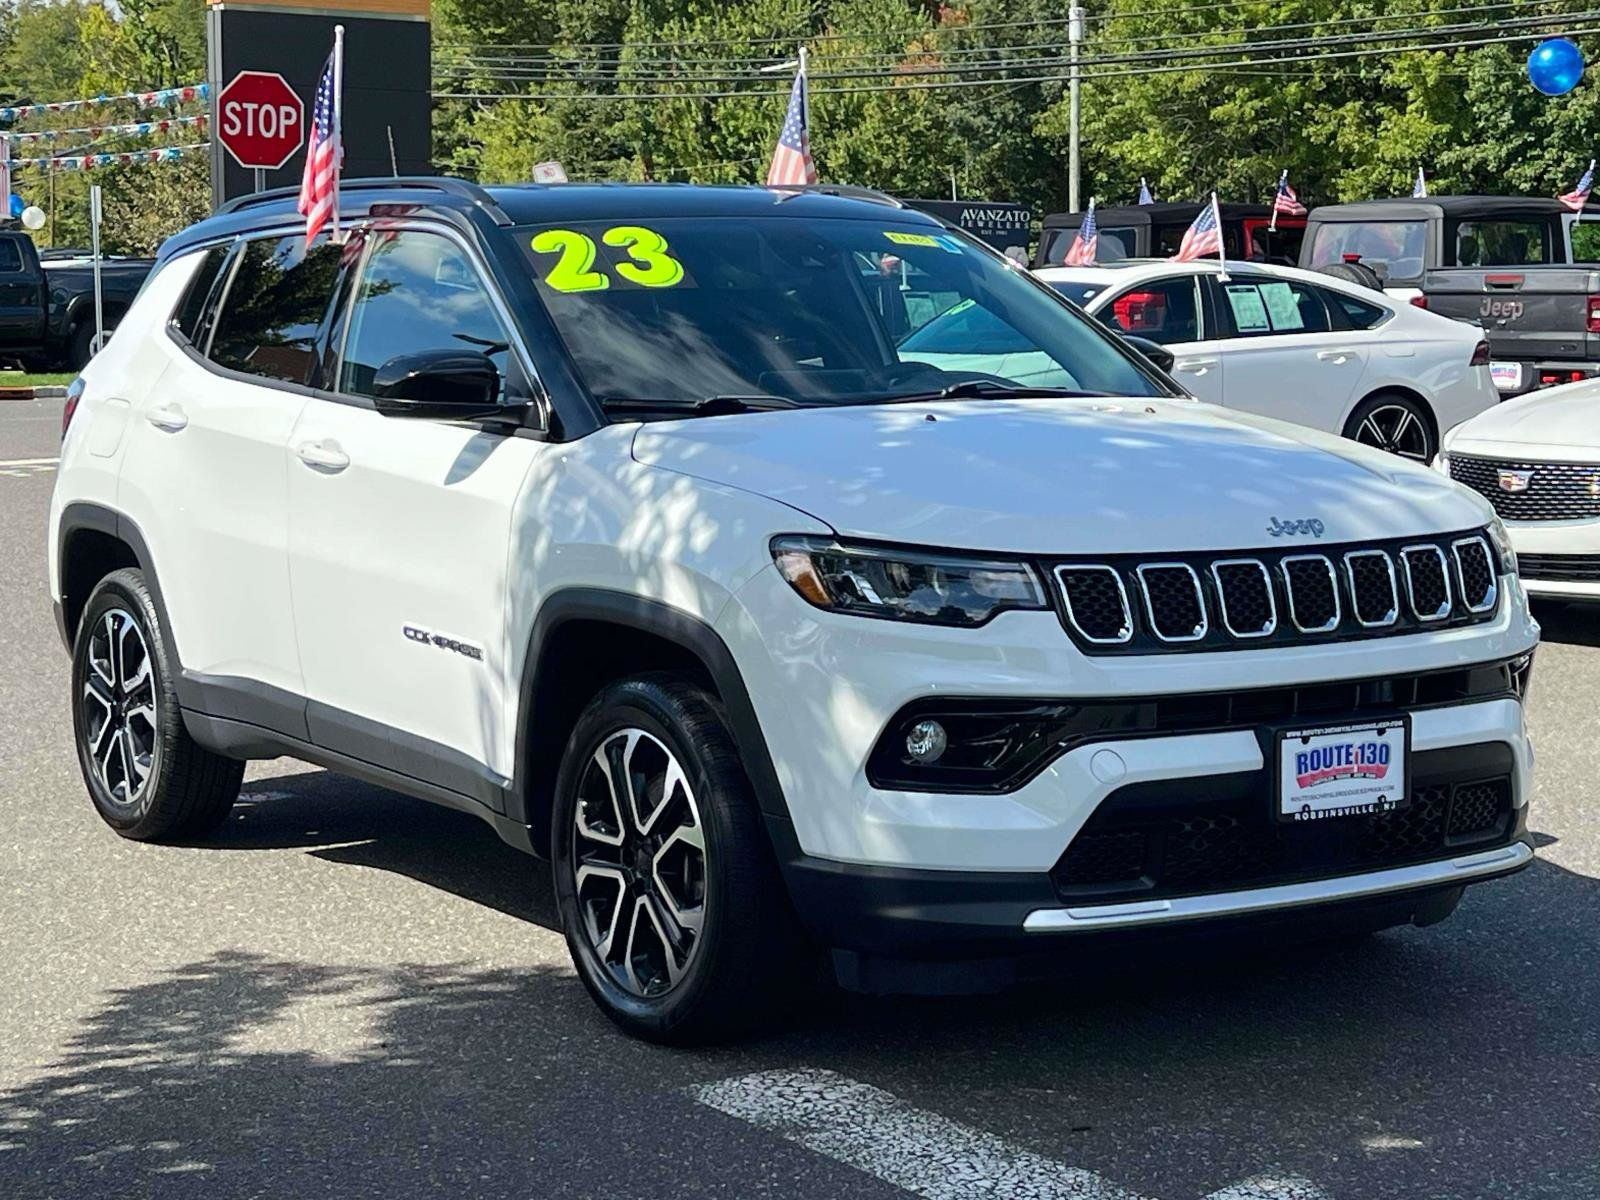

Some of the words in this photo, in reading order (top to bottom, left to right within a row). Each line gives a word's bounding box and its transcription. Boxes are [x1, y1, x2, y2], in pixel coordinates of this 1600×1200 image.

[223, 101, 297, 139] STOP
[960, 208, 1031, 222] AVANZATO
[960, 220, 1030, 229] JEWELERS
[531, 226, 685, 293] 23
[1480, 298, 1524, 320] Jeep
[1266, 516, 1325, 538] Jeep
[403, 626, 484, 662] COMPASS
[1296, 744, 1354, 775] ROUTE
[1357, 743, 1390, 765] 130
[1383, 802, 1396, 810] NJ
